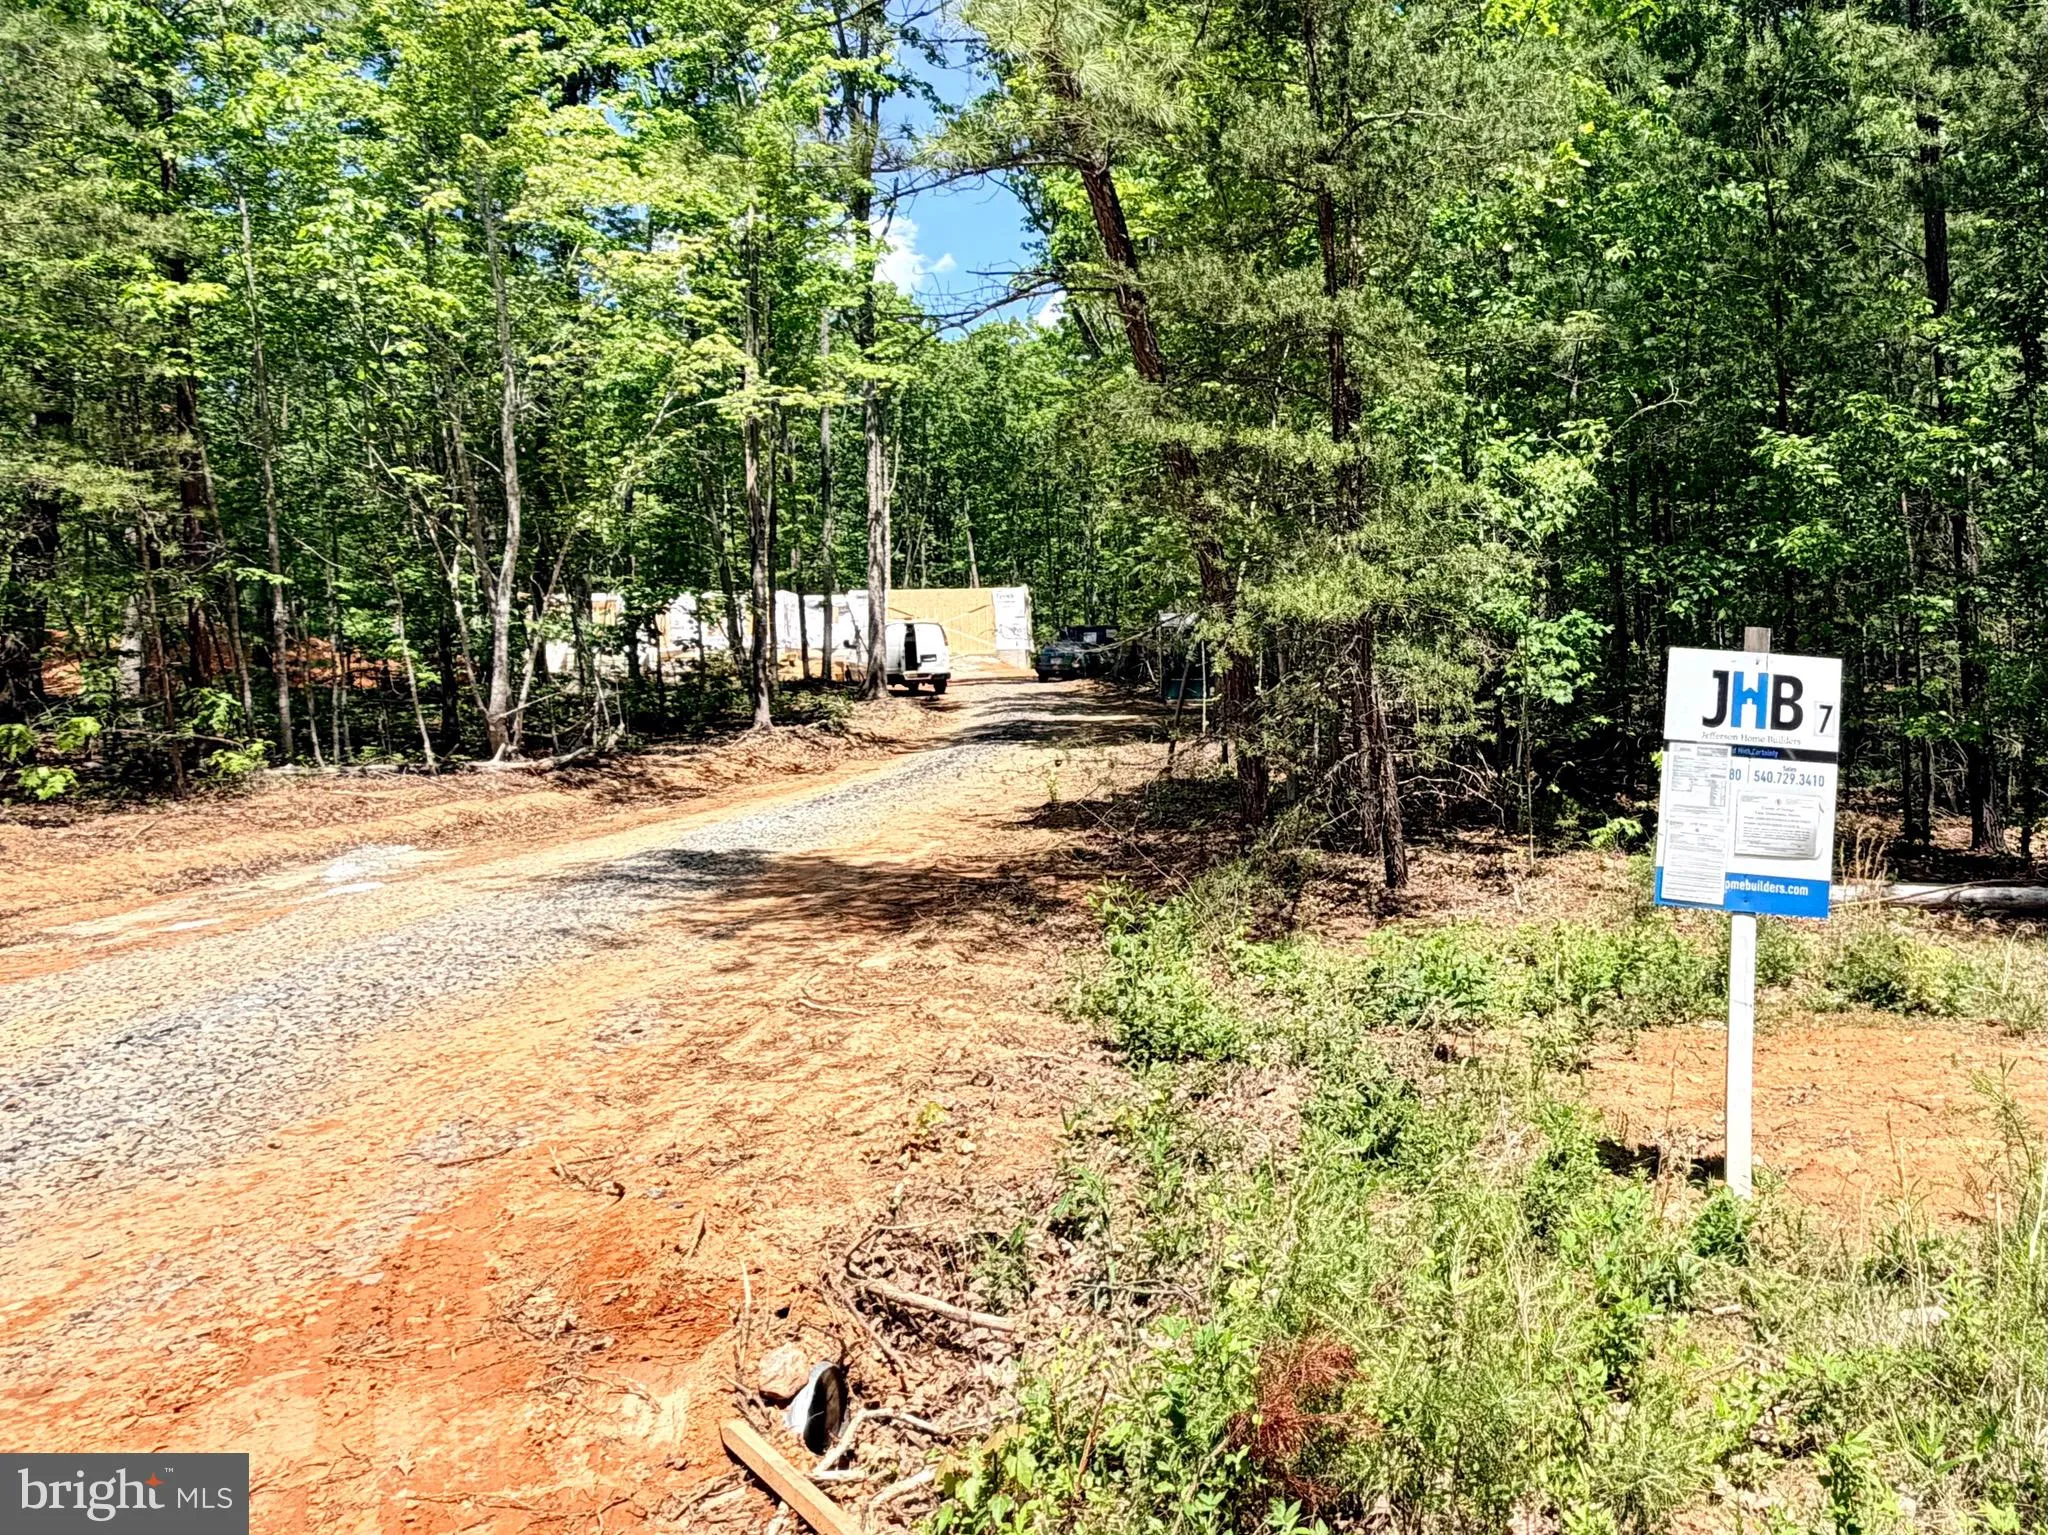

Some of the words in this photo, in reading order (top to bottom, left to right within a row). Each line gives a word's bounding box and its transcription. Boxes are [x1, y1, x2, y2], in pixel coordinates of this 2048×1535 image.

[1702, 669, 1804, 731] JHB
[1819, 704, 1833, 733] 7
[1701, 730, 1739, 741] Jefferson
[1741, 733, 1765, 742] Home
[1767, 734, 1801, 745] Builders
[1754, 770, 1825, 787] 540.729.3410
